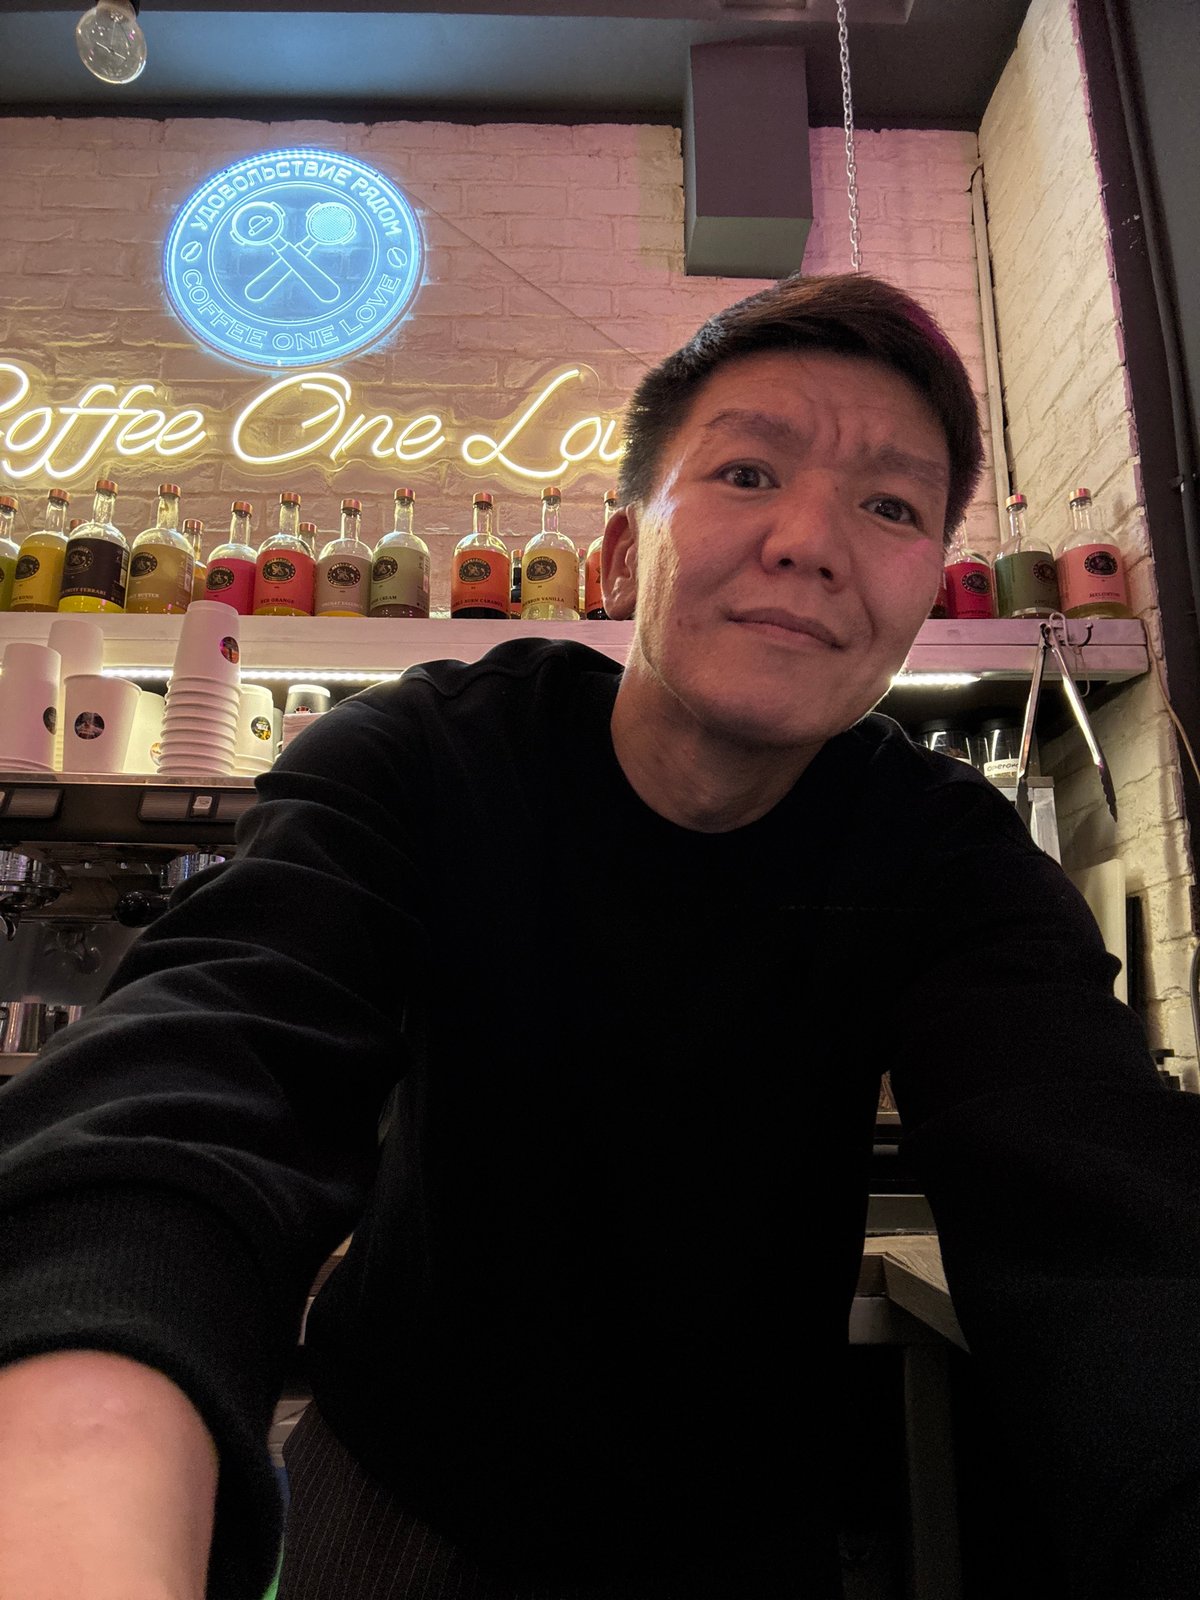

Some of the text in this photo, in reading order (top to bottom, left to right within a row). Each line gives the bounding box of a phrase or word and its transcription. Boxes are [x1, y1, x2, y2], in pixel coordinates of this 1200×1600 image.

[190, 160, 403, 237] УДОВОЛЬСТВИЕ РЯДОМ
[182, 268, 402, 351] COFFEE ONE LOVE
[232, 371, 446, 464] One
[462, 369, 633, 479] Lov
